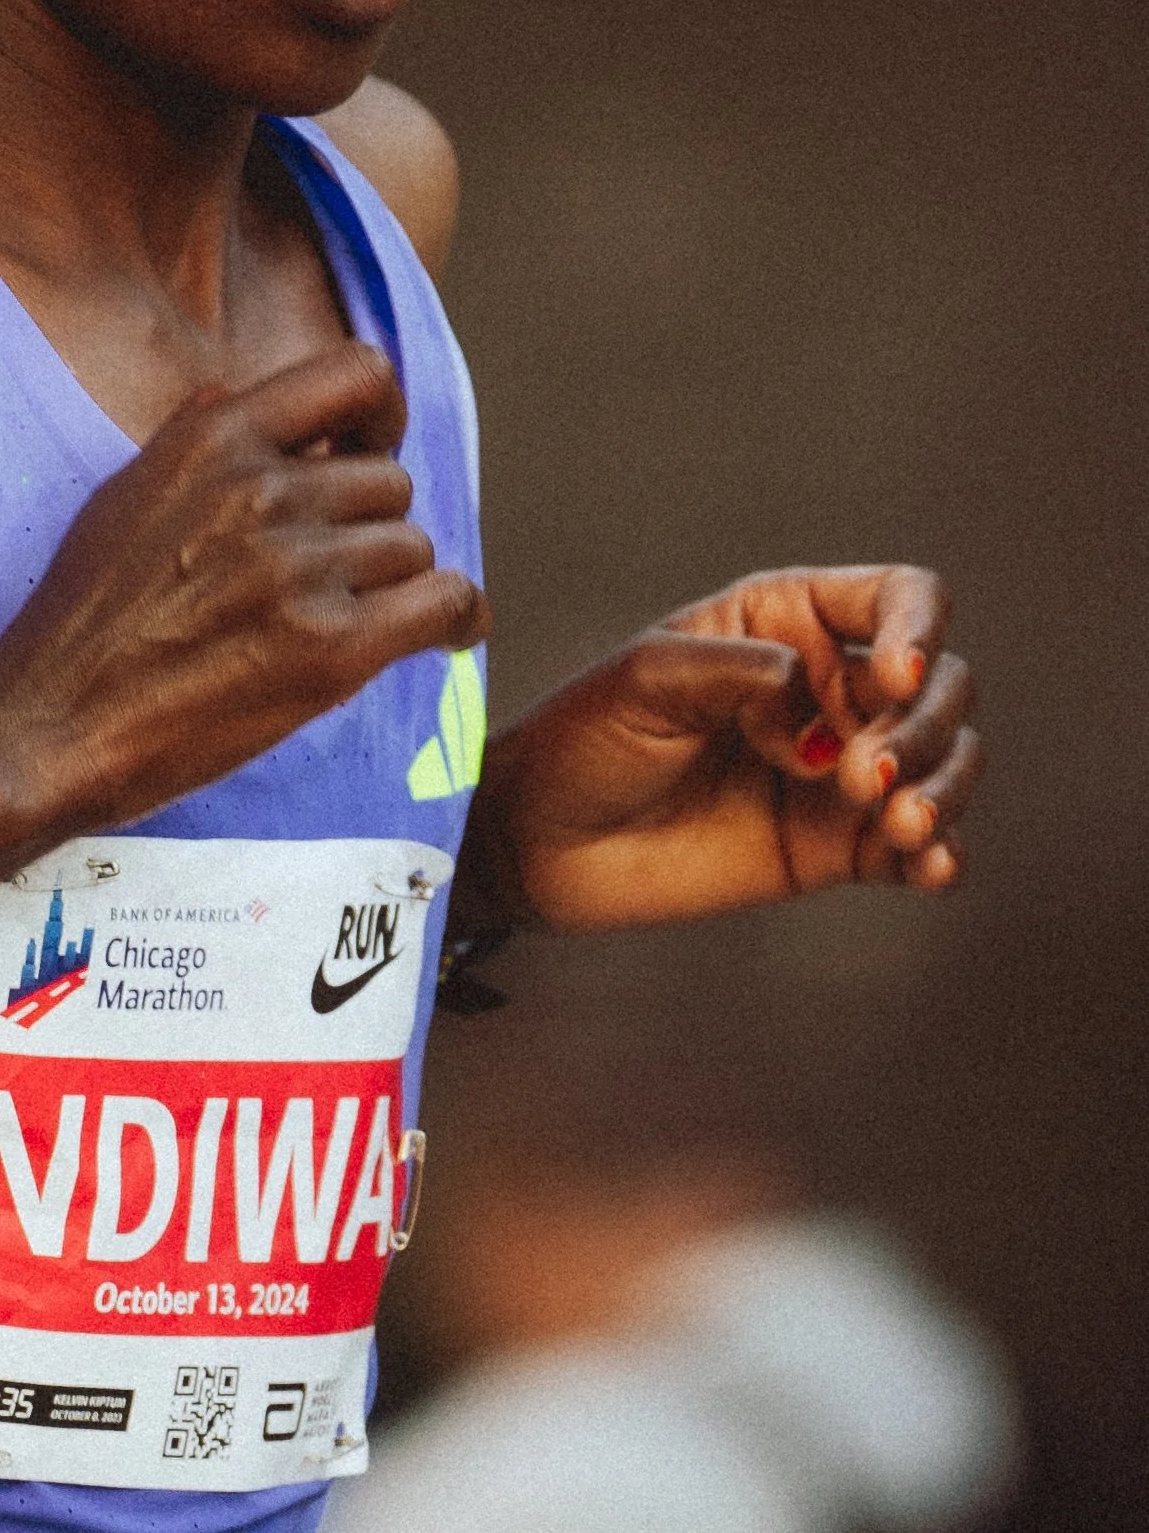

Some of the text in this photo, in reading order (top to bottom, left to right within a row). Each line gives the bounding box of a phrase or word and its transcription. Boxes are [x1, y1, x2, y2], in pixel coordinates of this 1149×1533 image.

[110, 907, 240, 923] BANK OF AMERICA
[333, 903, 400, 960] RUN
[105, 937, 207, 978] Chicago
[93, 1281, 310, 1320] October 13, 2024
[53, 1394, 88, 1407] KELVIN
